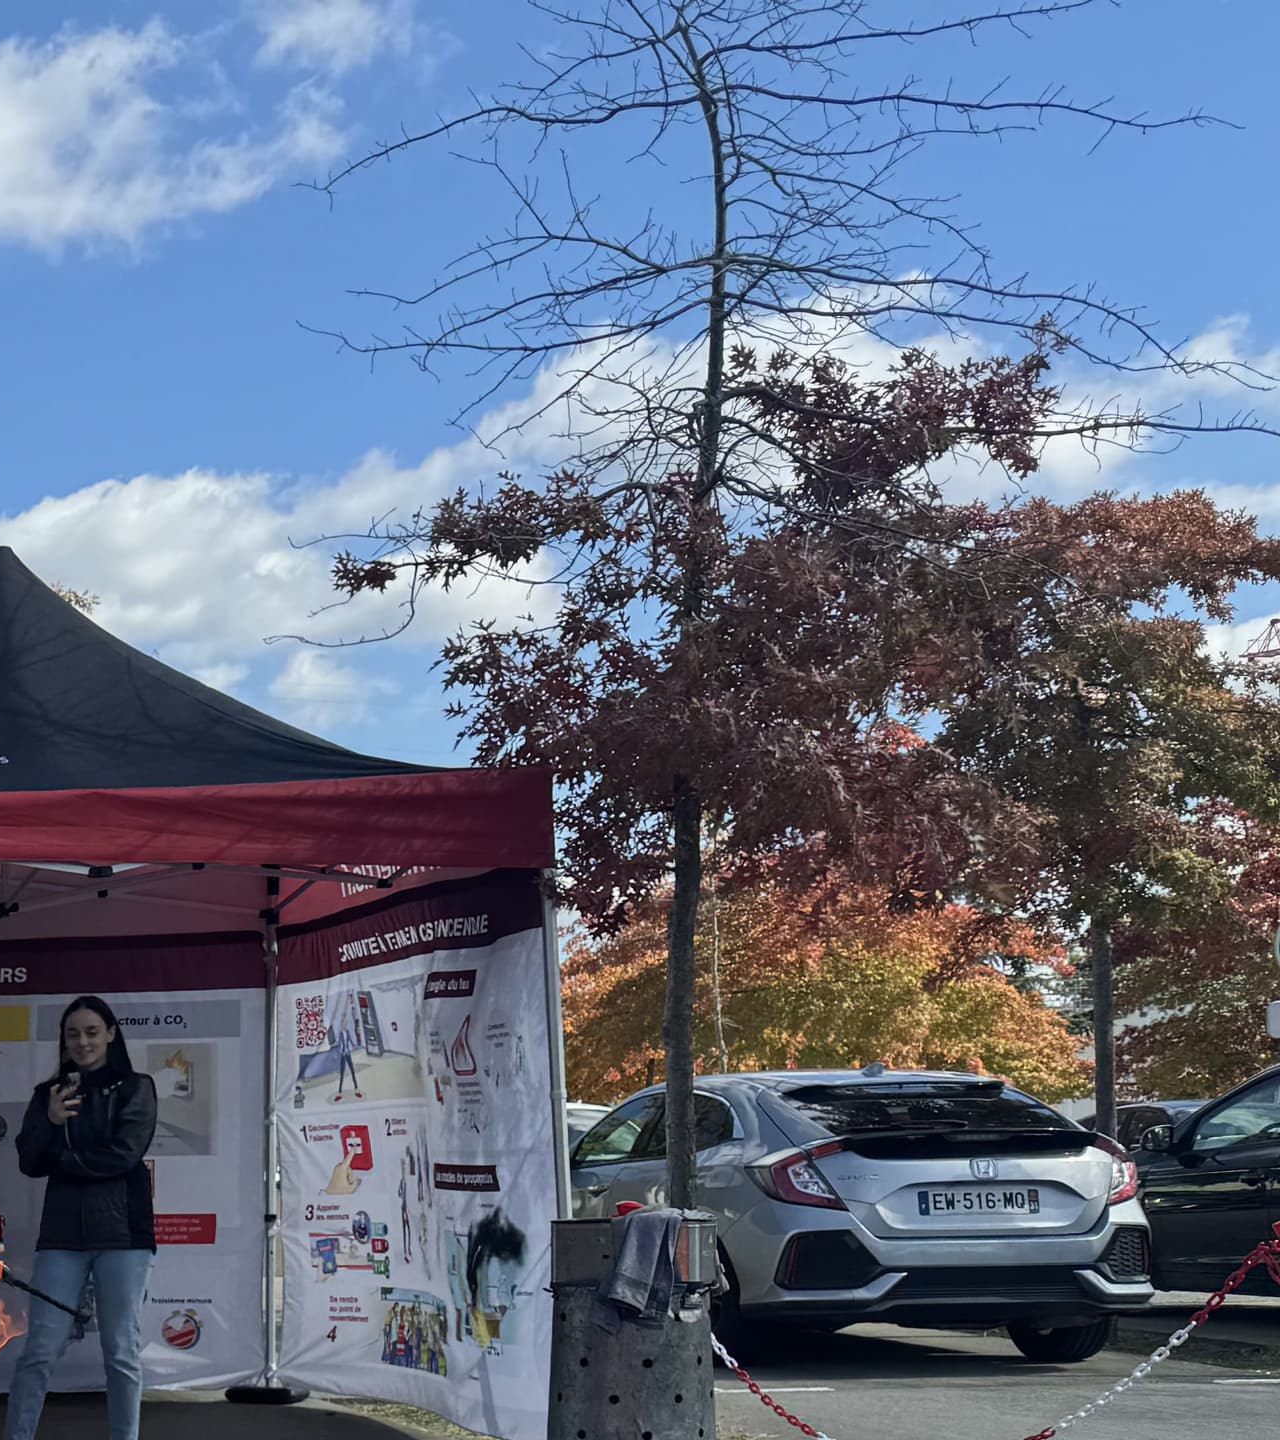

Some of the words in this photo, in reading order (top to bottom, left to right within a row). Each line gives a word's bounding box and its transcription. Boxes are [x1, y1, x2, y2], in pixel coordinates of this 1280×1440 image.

[118, 1016, 151, 1026] cteur
[933, 1191, 1026, 1211] EW-516-MQ
[305, 1204, 314, 1221] 3
[326, 1325, 337, 1342] 4
